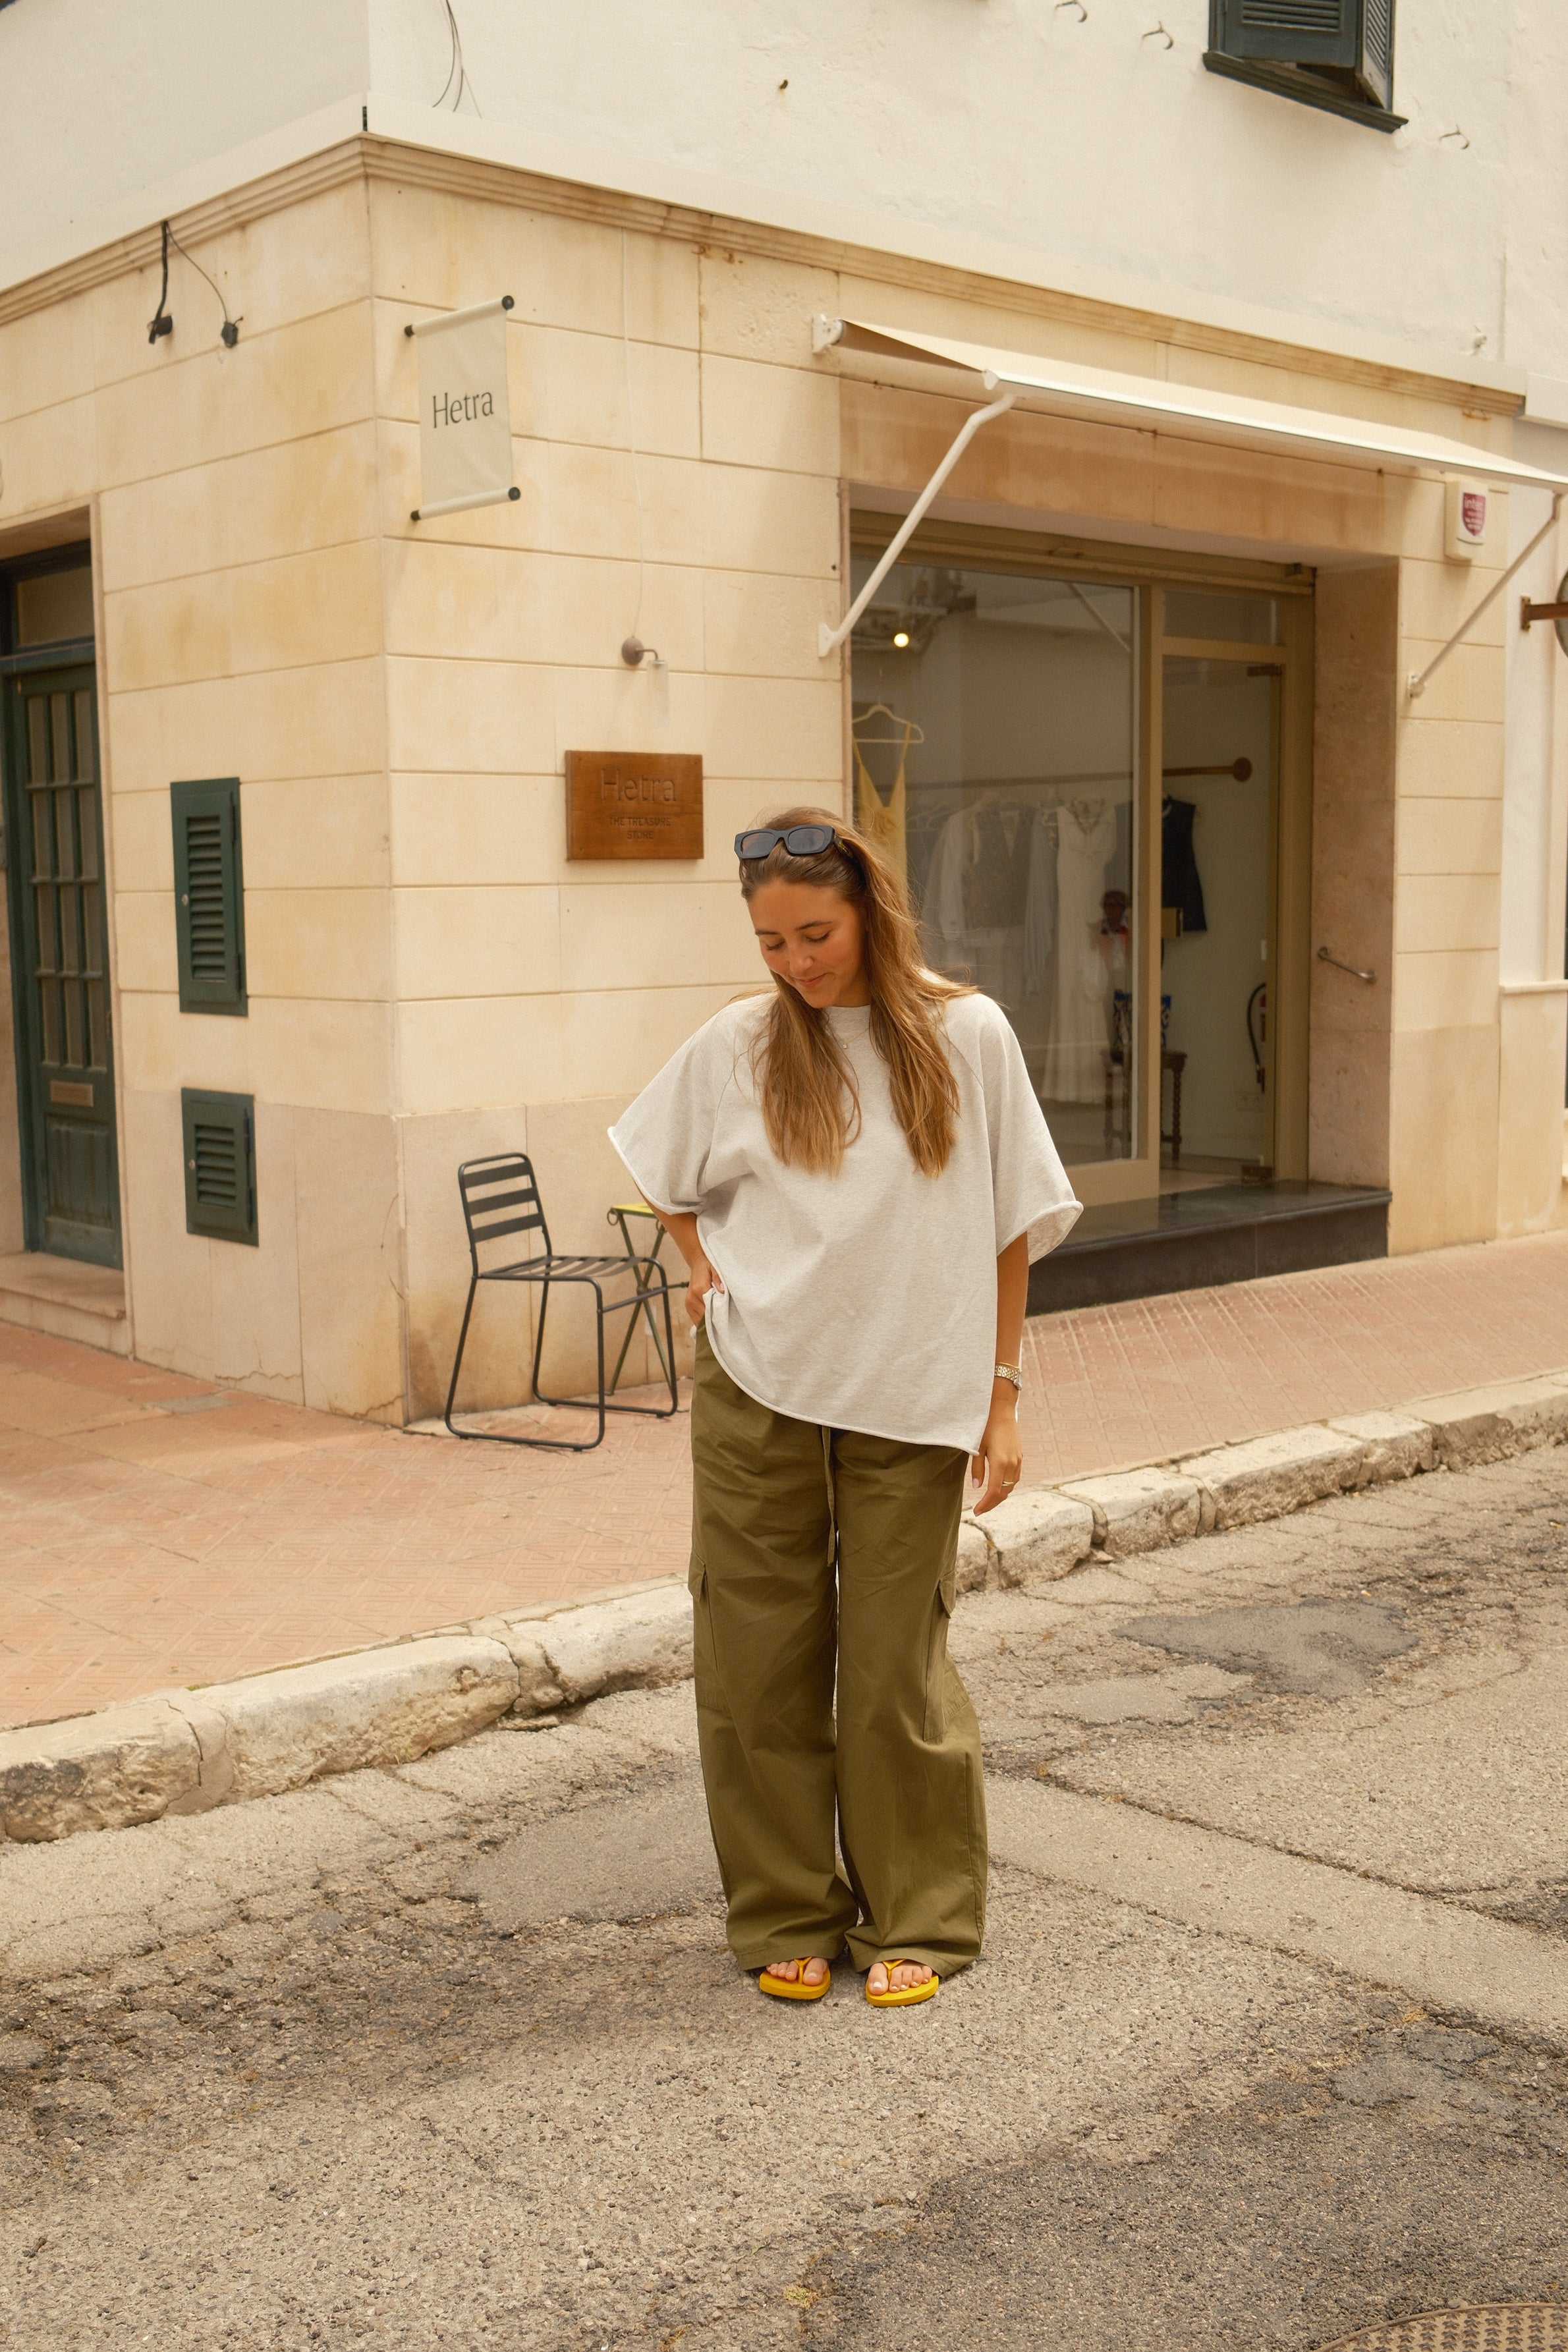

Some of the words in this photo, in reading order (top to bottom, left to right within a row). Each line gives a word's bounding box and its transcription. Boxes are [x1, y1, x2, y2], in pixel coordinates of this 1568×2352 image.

[432, 391, 494, 428] Hetra
[601, 768, 677, 802] Hetra
[609, 816, 625, 826] THE
[627, 817, 671, 826] TREASURE
[627, 831, 654, 839] STORE
